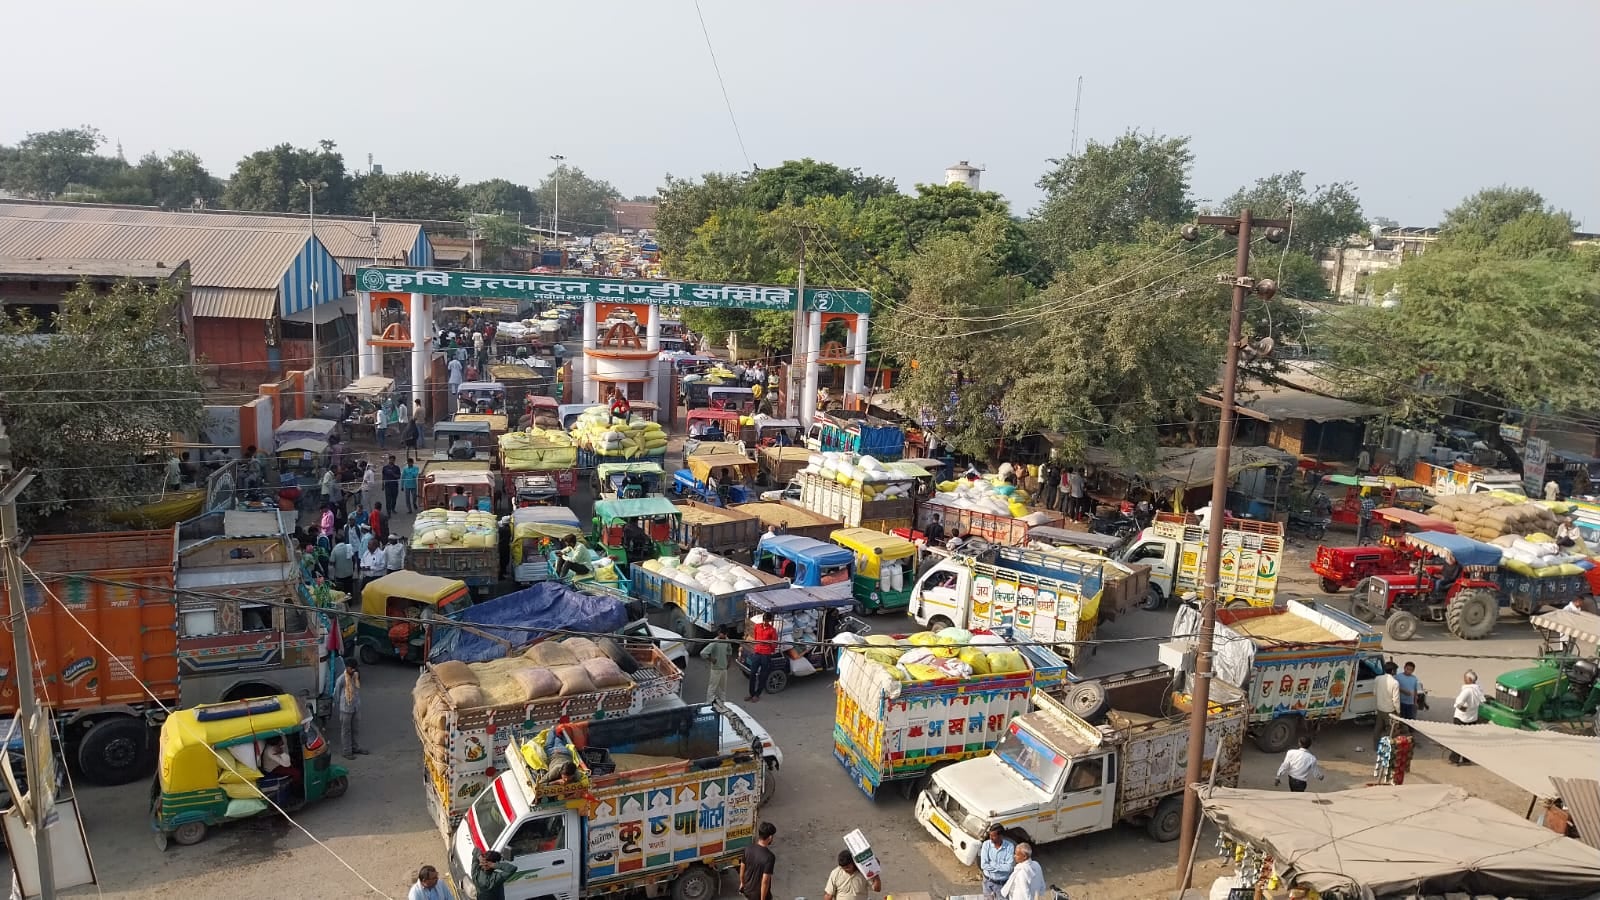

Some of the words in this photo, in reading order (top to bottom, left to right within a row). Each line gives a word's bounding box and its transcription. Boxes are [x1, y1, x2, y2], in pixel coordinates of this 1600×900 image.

[385, 271, 452, 292] कृषि
[461, 276, 590, 294] उत्पादन
[598, 282, 683, 298] मण्डी
[691, 286, 794, 304] समिति
[818, 299, 828, 310] 2
[976, 586, 989, 597] जय
